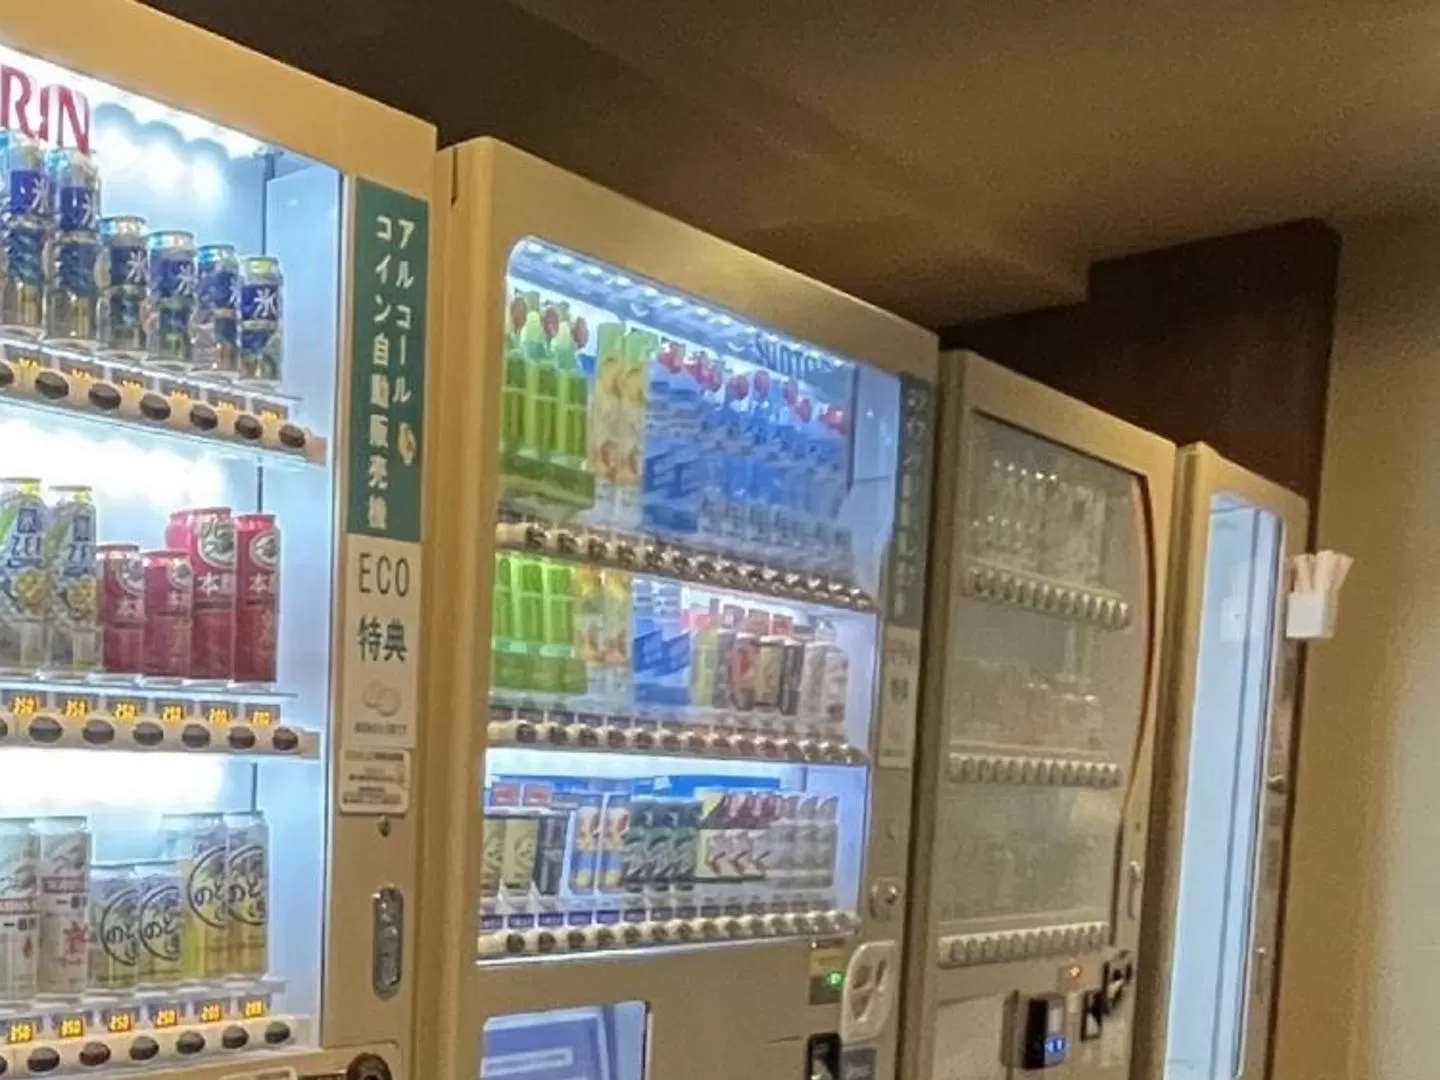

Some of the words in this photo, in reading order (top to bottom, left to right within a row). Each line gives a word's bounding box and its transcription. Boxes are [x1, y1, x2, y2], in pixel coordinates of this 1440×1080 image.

[391, 218, 415, 404] アルコール
[359, 553, 410, 598] ECO
[356, 615, 408, 663] 特典
